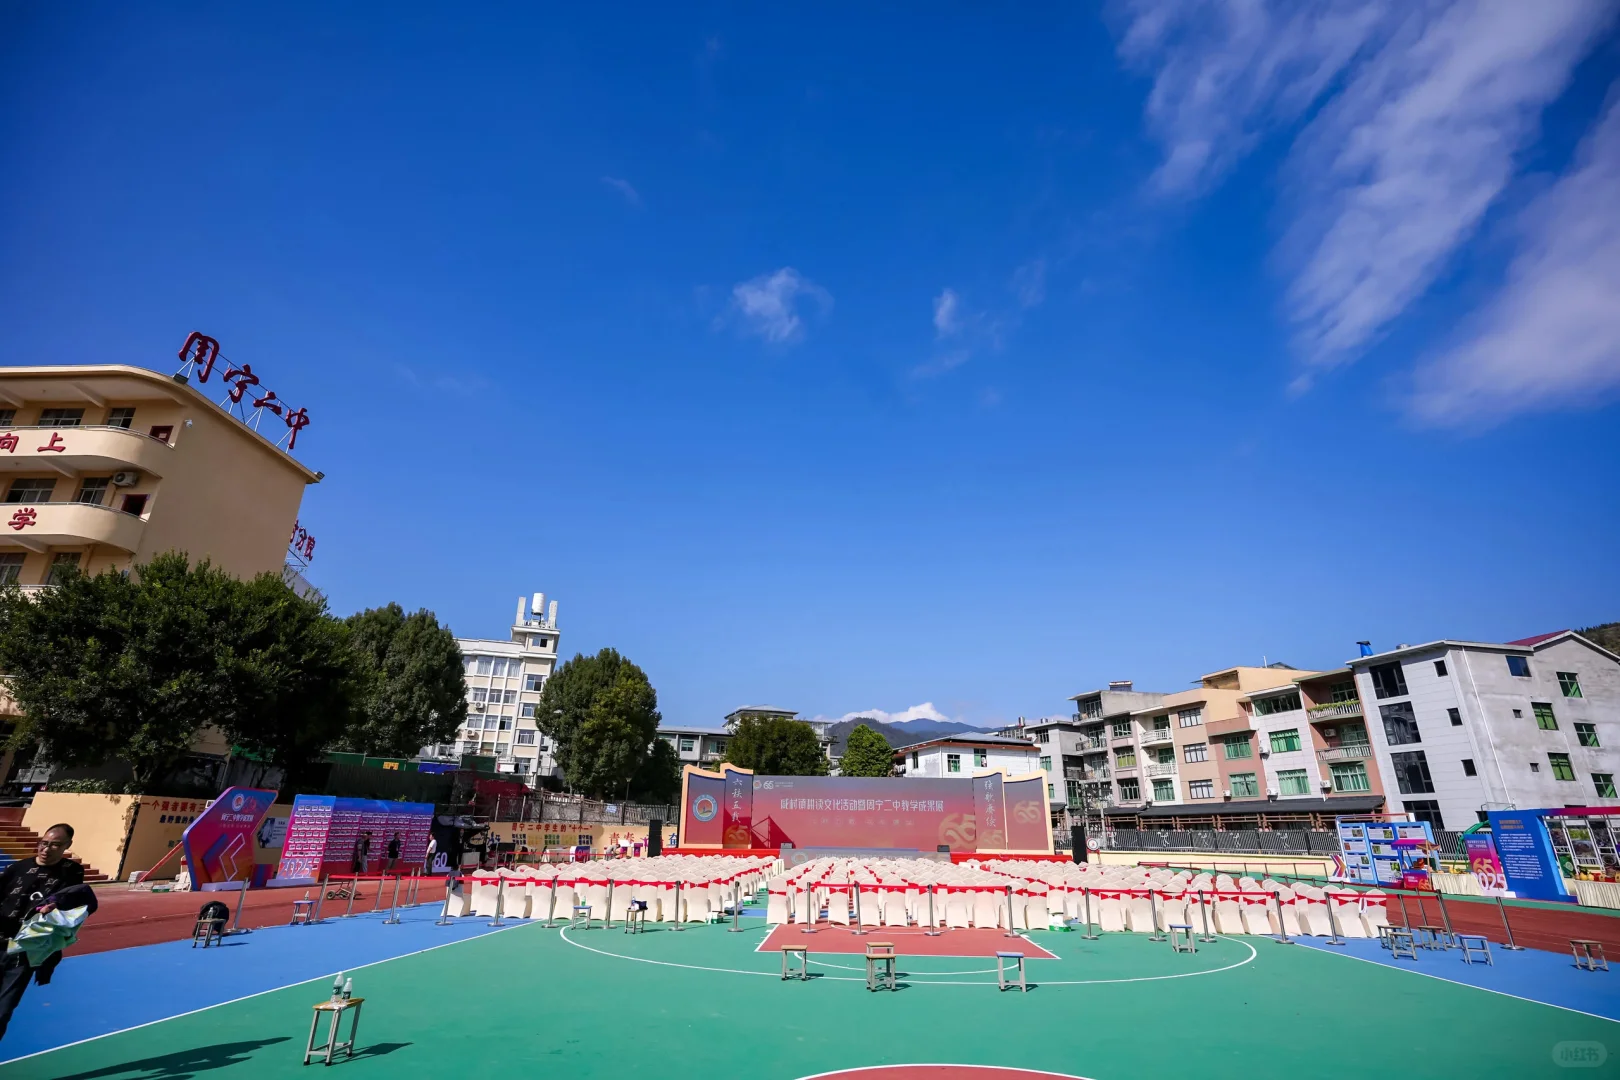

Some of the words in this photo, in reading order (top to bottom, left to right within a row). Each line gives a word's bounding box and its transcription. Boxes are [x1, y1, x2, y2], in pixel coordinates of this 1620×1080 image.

[178, 331, 310, 449] 周宁二中
[0, 432, 66, 453] 向上
[8, 507, 37, 531] 学
[279, 858, 313, 879] 2025
